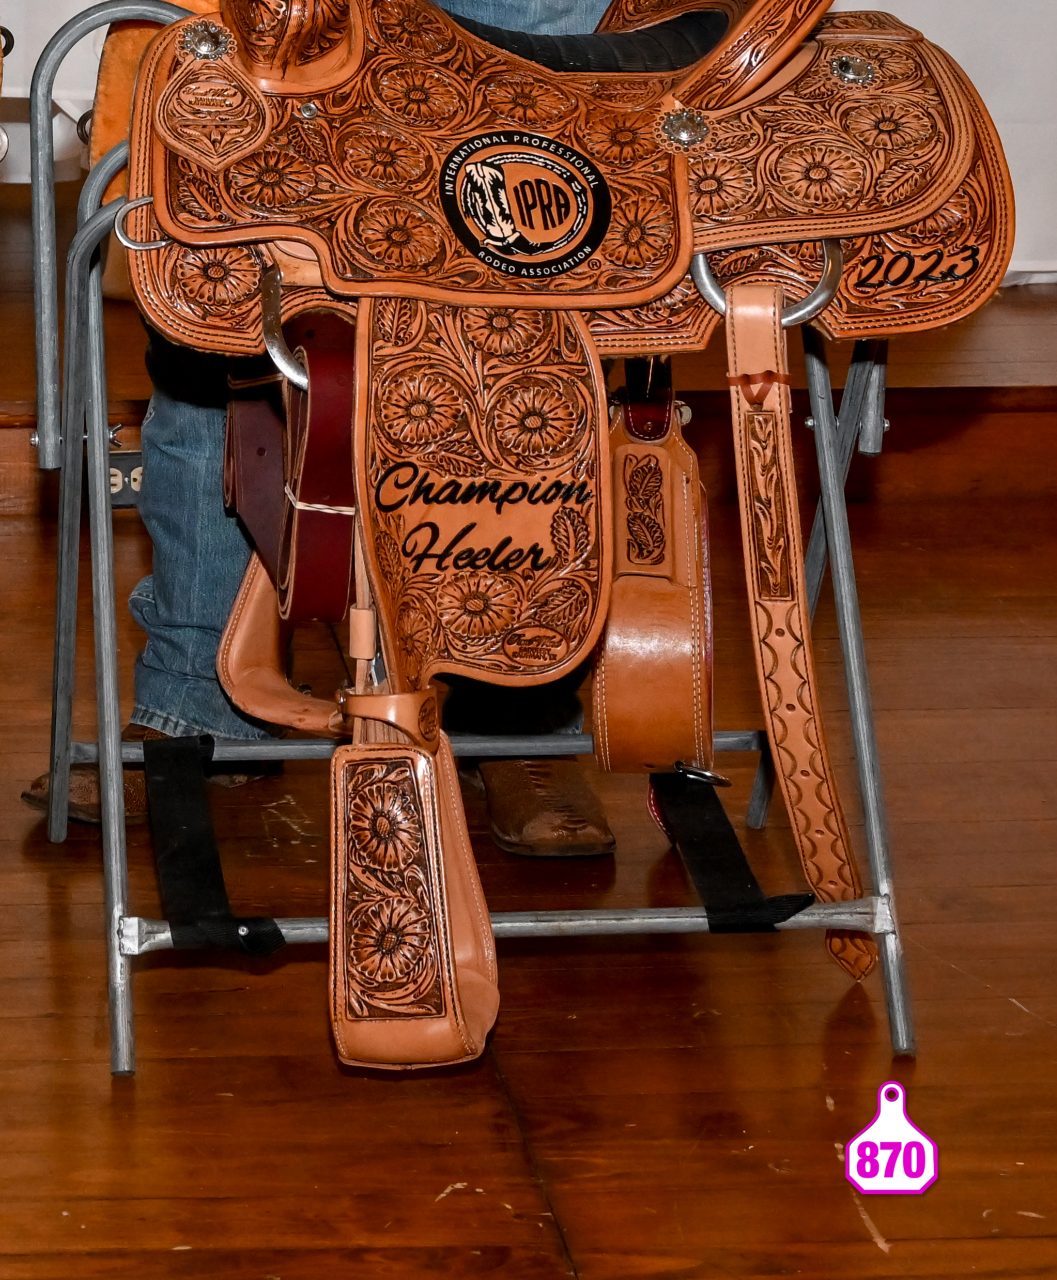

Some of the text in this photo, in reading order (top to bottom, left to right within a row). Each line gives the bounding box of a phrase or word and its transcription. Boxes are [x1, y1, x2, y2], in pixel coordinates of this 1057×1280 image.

[445, 135, 600, 195] INTERNATIONAL PROFESSIONAL
[513, 178, 571, 231] IPRA
[478, 245, 593, 276] RODEO ASSOCIATION
[854, 244, 980, 288] 2023
[374, 461, 593, 515] Champion
[401, 521, 551, 574] Heeler
